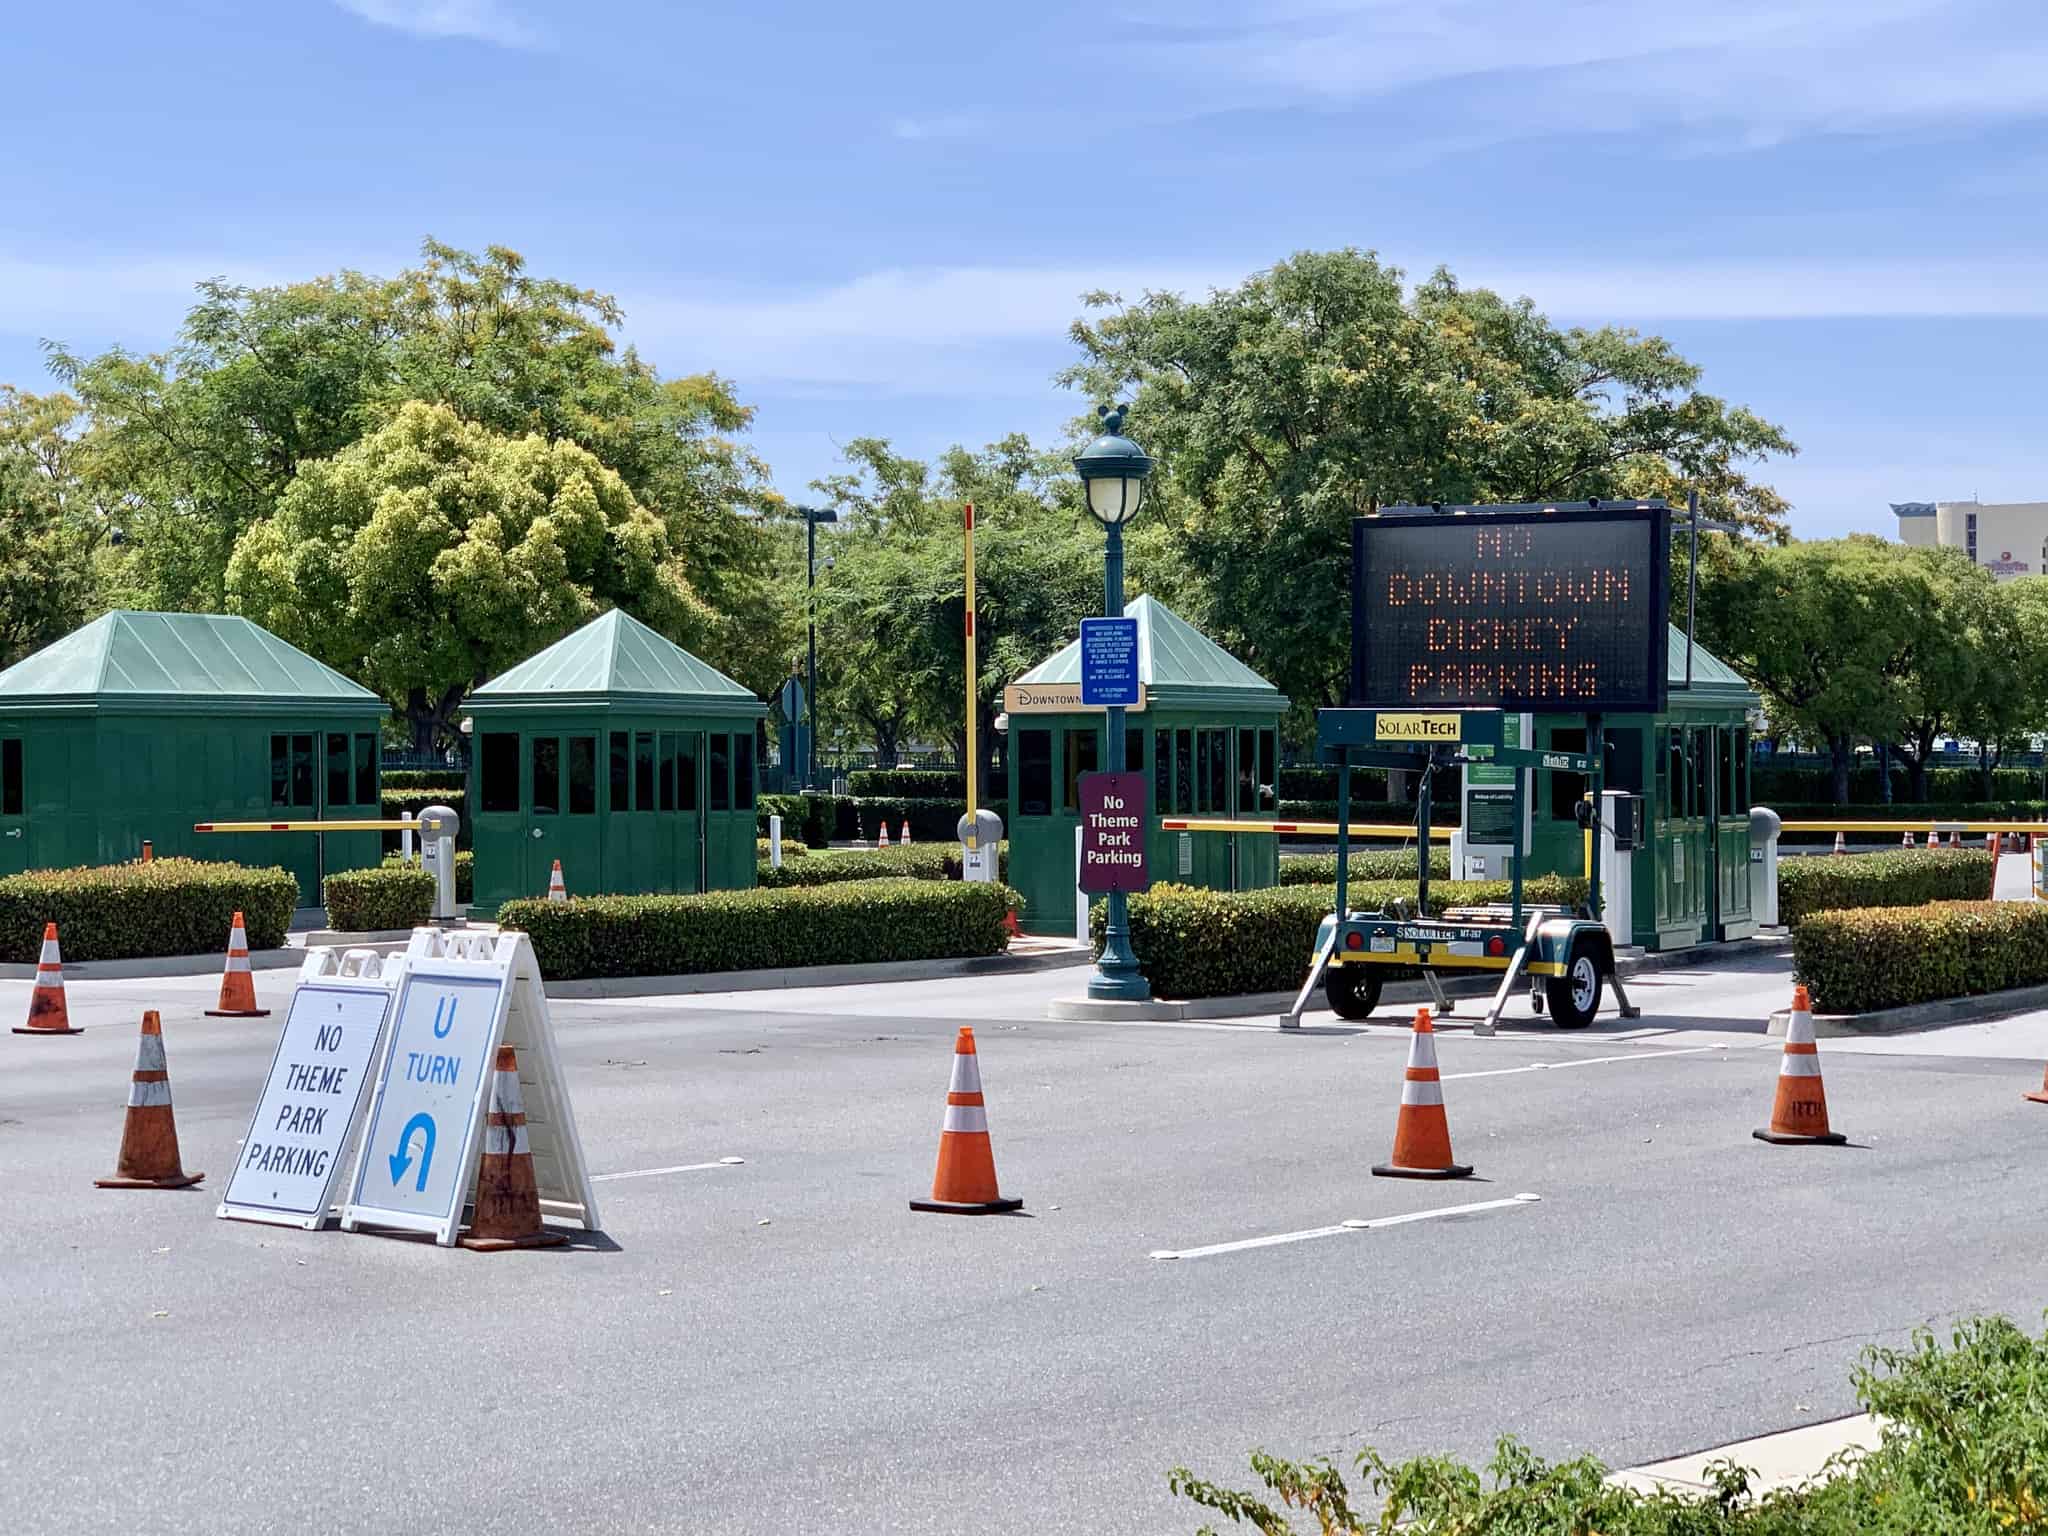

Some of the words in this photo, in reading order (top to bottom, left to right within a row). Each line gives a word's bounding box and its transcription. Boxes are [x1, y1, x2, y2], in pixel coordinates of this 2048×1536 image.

[1476, 526, 1531, 559] NO
[1388, 568, 1630, 605] DOWNTOWN
[1428, 617, 1578, 651] DISNEY
[1409, 663, 1599, 697] PARKING
[1103, 795, 1124, 809] No
[1089, 812, 1138, 828] Theme
[1098, 831, 1131, 846] Park
[1087, 850, 1142, 868] Parking
[433, 996, 457, 1039] U
[313, 1024, 343, 1053] NO
[285, 1063, 348, 1095] THEME
[405, 1052, 461, 1086] TURN
[275, 1104, 327, 1136] PARK
[244, 1143, 329, 1179] PARKING
